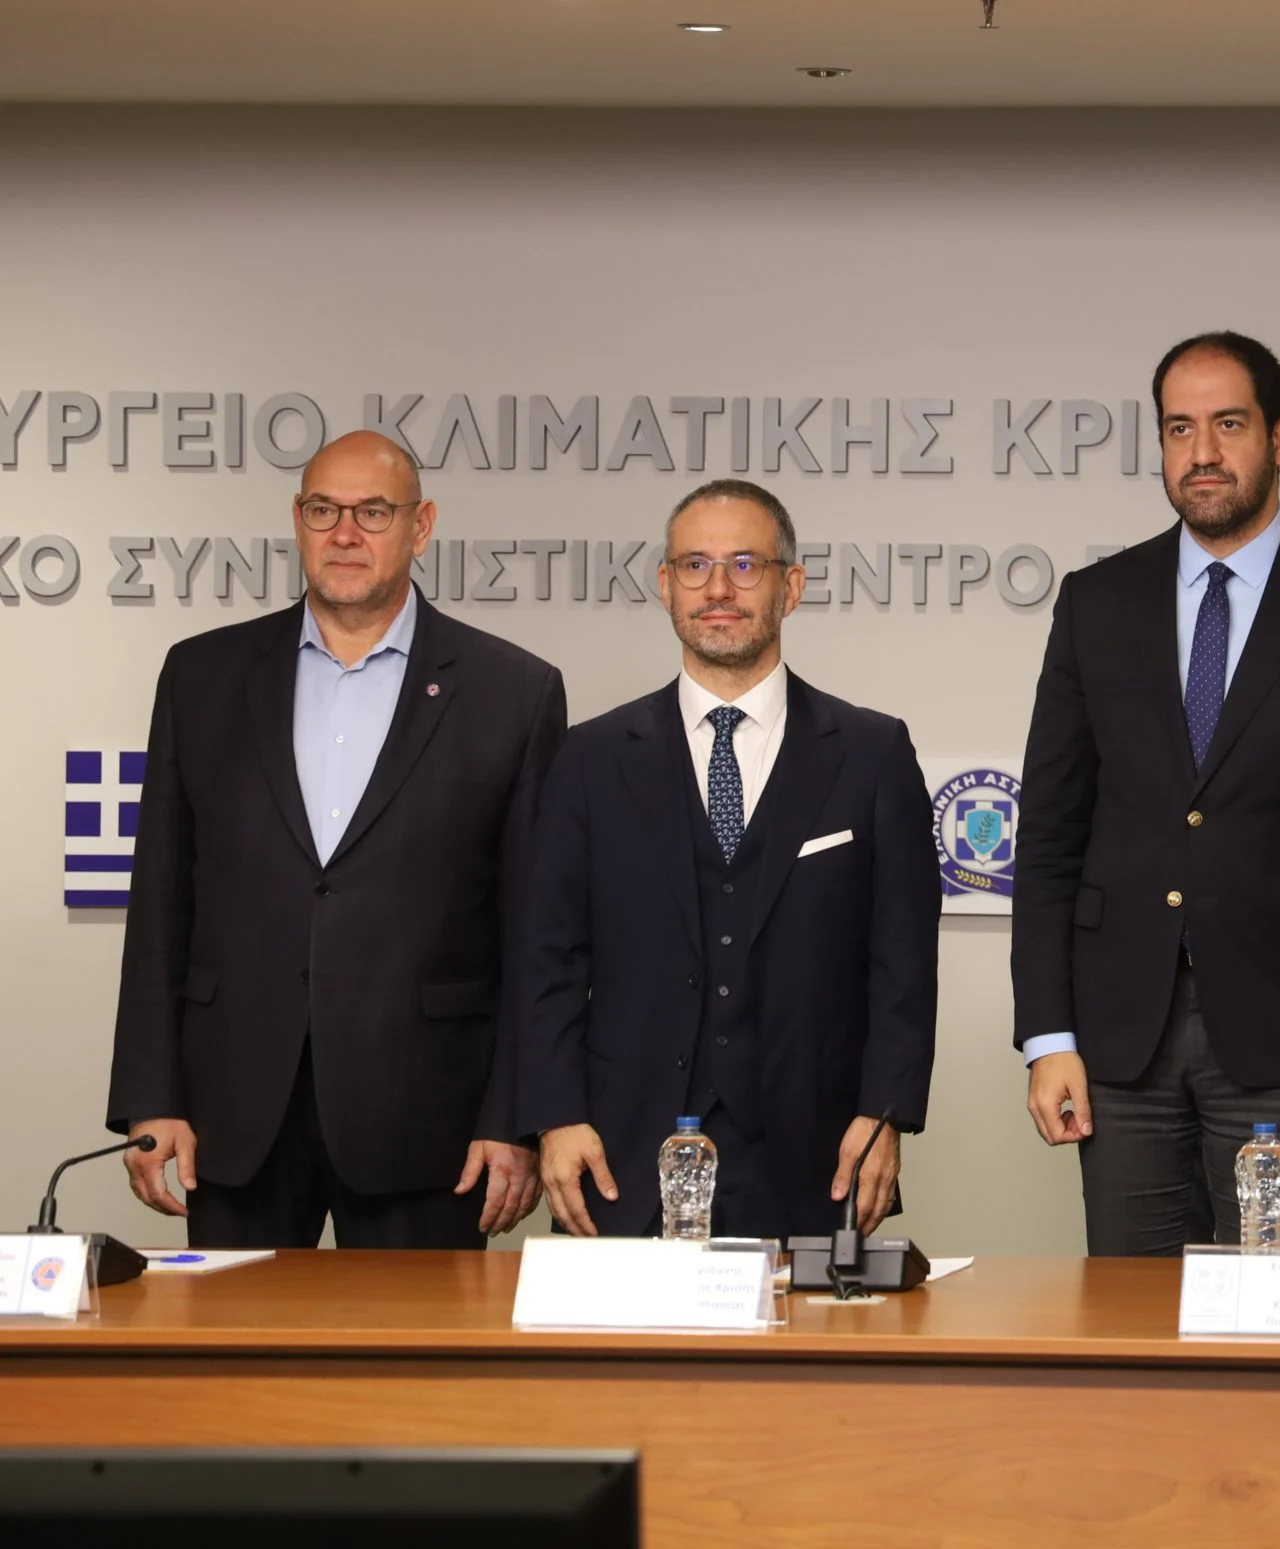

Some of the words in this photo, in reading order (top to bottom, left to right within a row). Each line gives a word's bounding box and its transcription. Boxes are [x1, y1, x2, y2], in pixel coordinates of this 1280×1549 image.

[0, 389, 327, 470] ΥΡΓΕΙΟ
[363, 391, 954, 476] ΚΛΙΜΑΤΙΚΗΣ
[110, 536, 665, 604] ΣΥΝΤΝΙΣΤΙΚ
[796, 541, 1055, 608] ΕΝΤΡΟ
[983, 772, 1022, 796] ΑΣΤ
